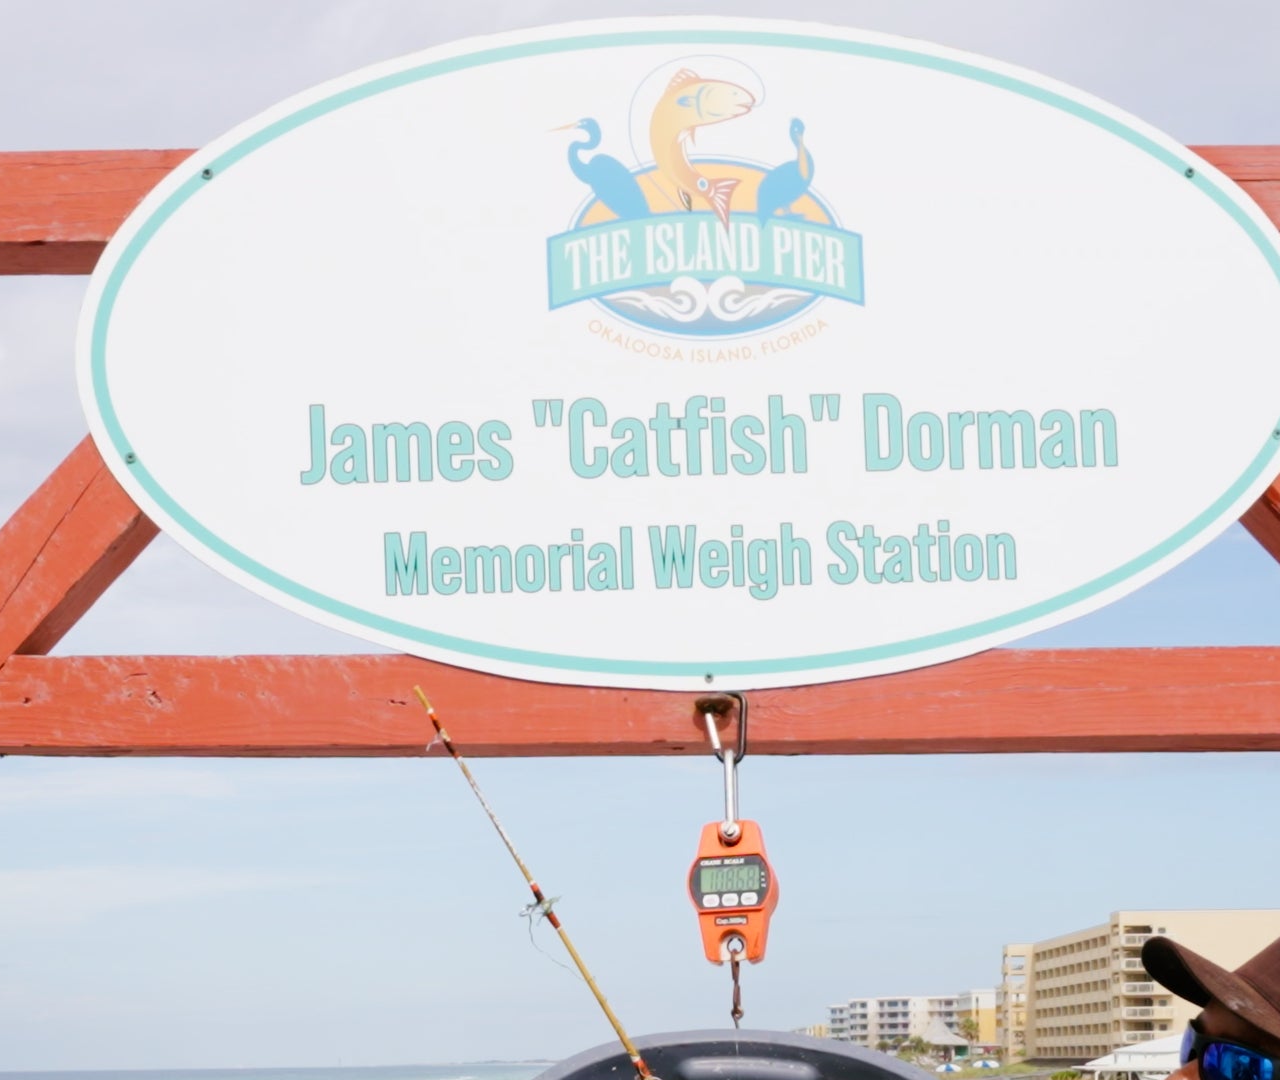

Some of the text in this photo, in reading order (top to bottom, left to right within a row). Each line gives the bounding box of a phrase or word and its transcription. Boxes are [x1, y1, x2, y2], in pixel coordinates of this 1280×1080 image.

[564, 220, 846, 290] THE ISLAND PIER
[588, 318, 829, 363] OKALOOSA ISLAND, FLORIDA
[300, 392, 1119, 486] James "Catfish" Dorman
[383, 520, 1018, 601] Memorial Weigh Station
